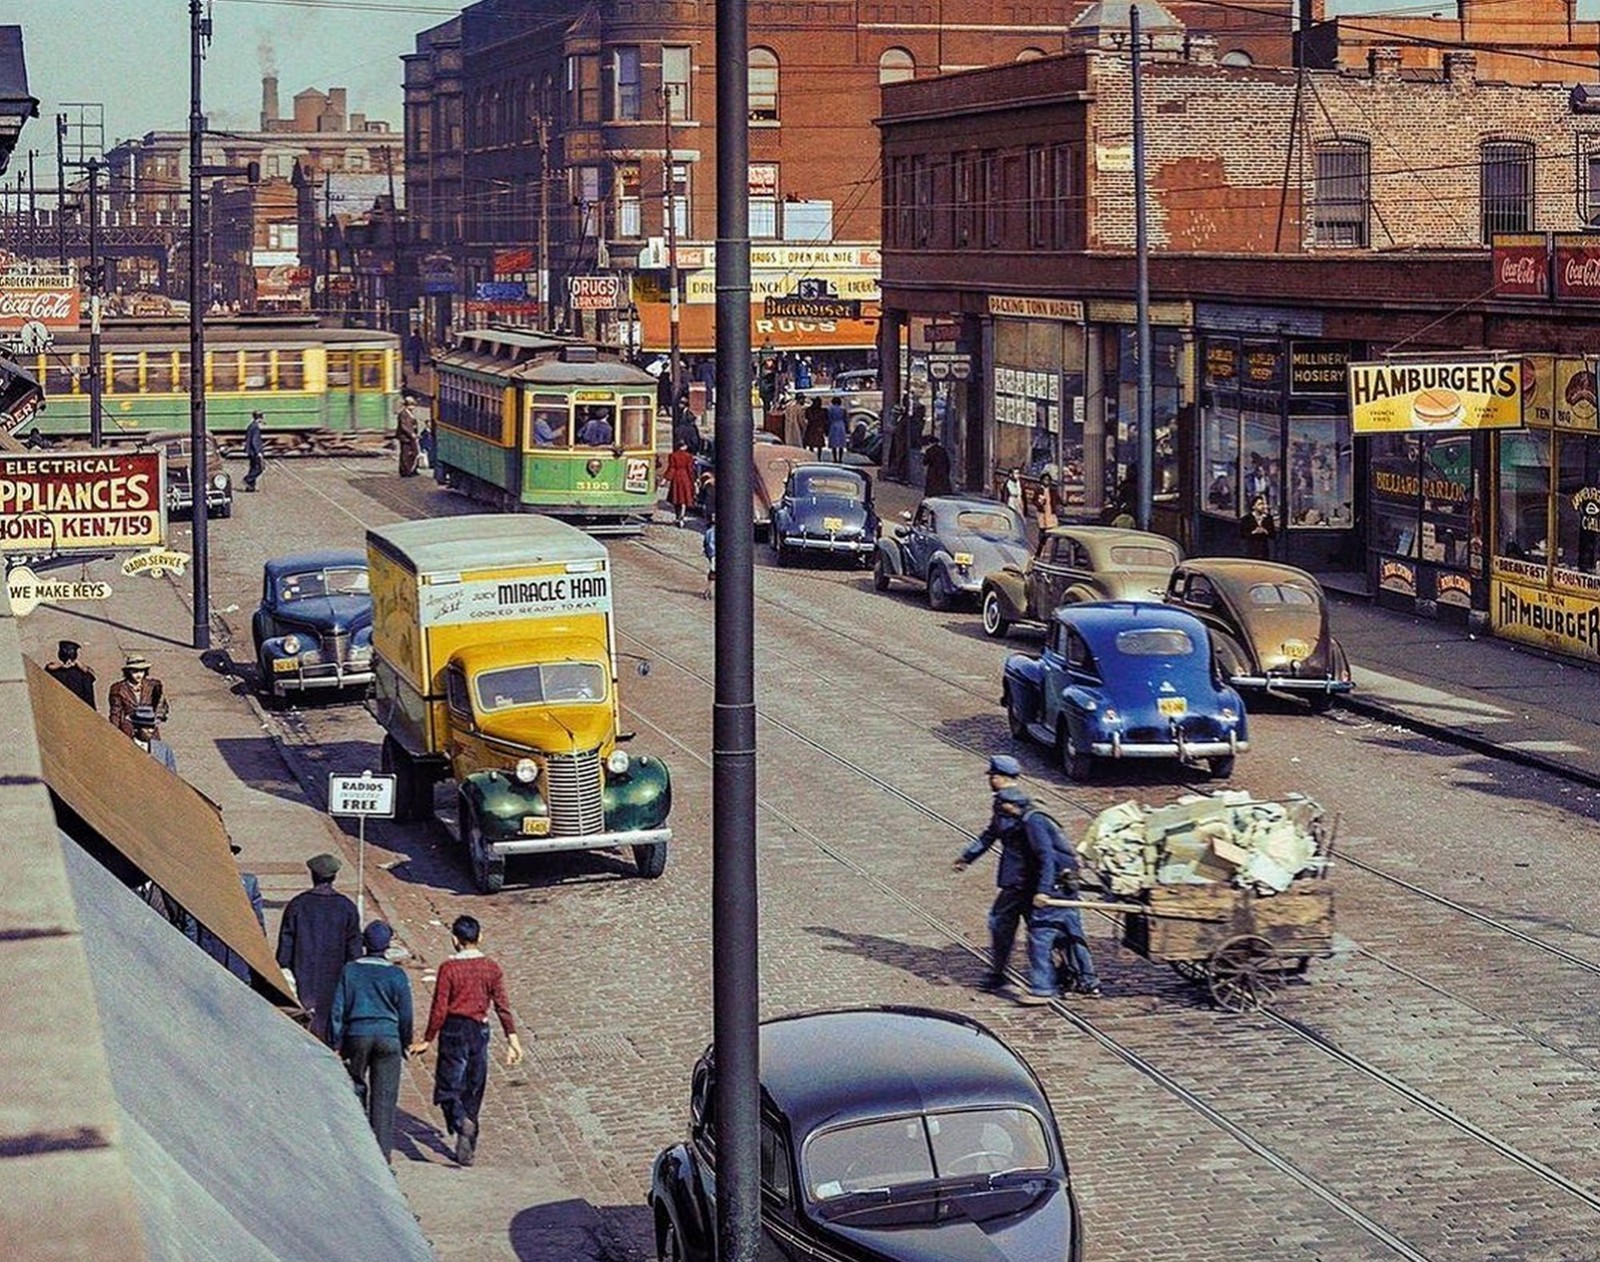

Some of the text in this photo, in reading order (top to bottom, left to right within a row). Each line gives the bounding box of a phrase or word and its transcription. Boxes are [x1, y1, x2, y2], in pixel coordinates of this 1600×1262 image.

[788, 252, 811, 263] OPEN
[833, 252, 852, 263] NITE
[38, 276, 70, 287] MARKET
[572, 280, 615, 295] DRUGS
[1293, 353, 1349, 365] MILLINERY
[1294, 370, 1345, 382] HOSIERY
[1353, 365, 1517, 405] HAMBURGERS
[6, 459, 121, 475] ELECTRICAL
[62, 515, 152, 538] KEN.7159
[124, 555, 181, 573] RADIO SERVICE
[1500, 559, 1546, 579] BREAKFAST
[10, 583, 104, 598] WE MAKE KEYS
[498, 577, 606, 605] MIRACLE HAM
[519, 605, 555, 613] READY
[342, 782, 384, 791] RADIOS
[342, 799, 378, 810] FREE
